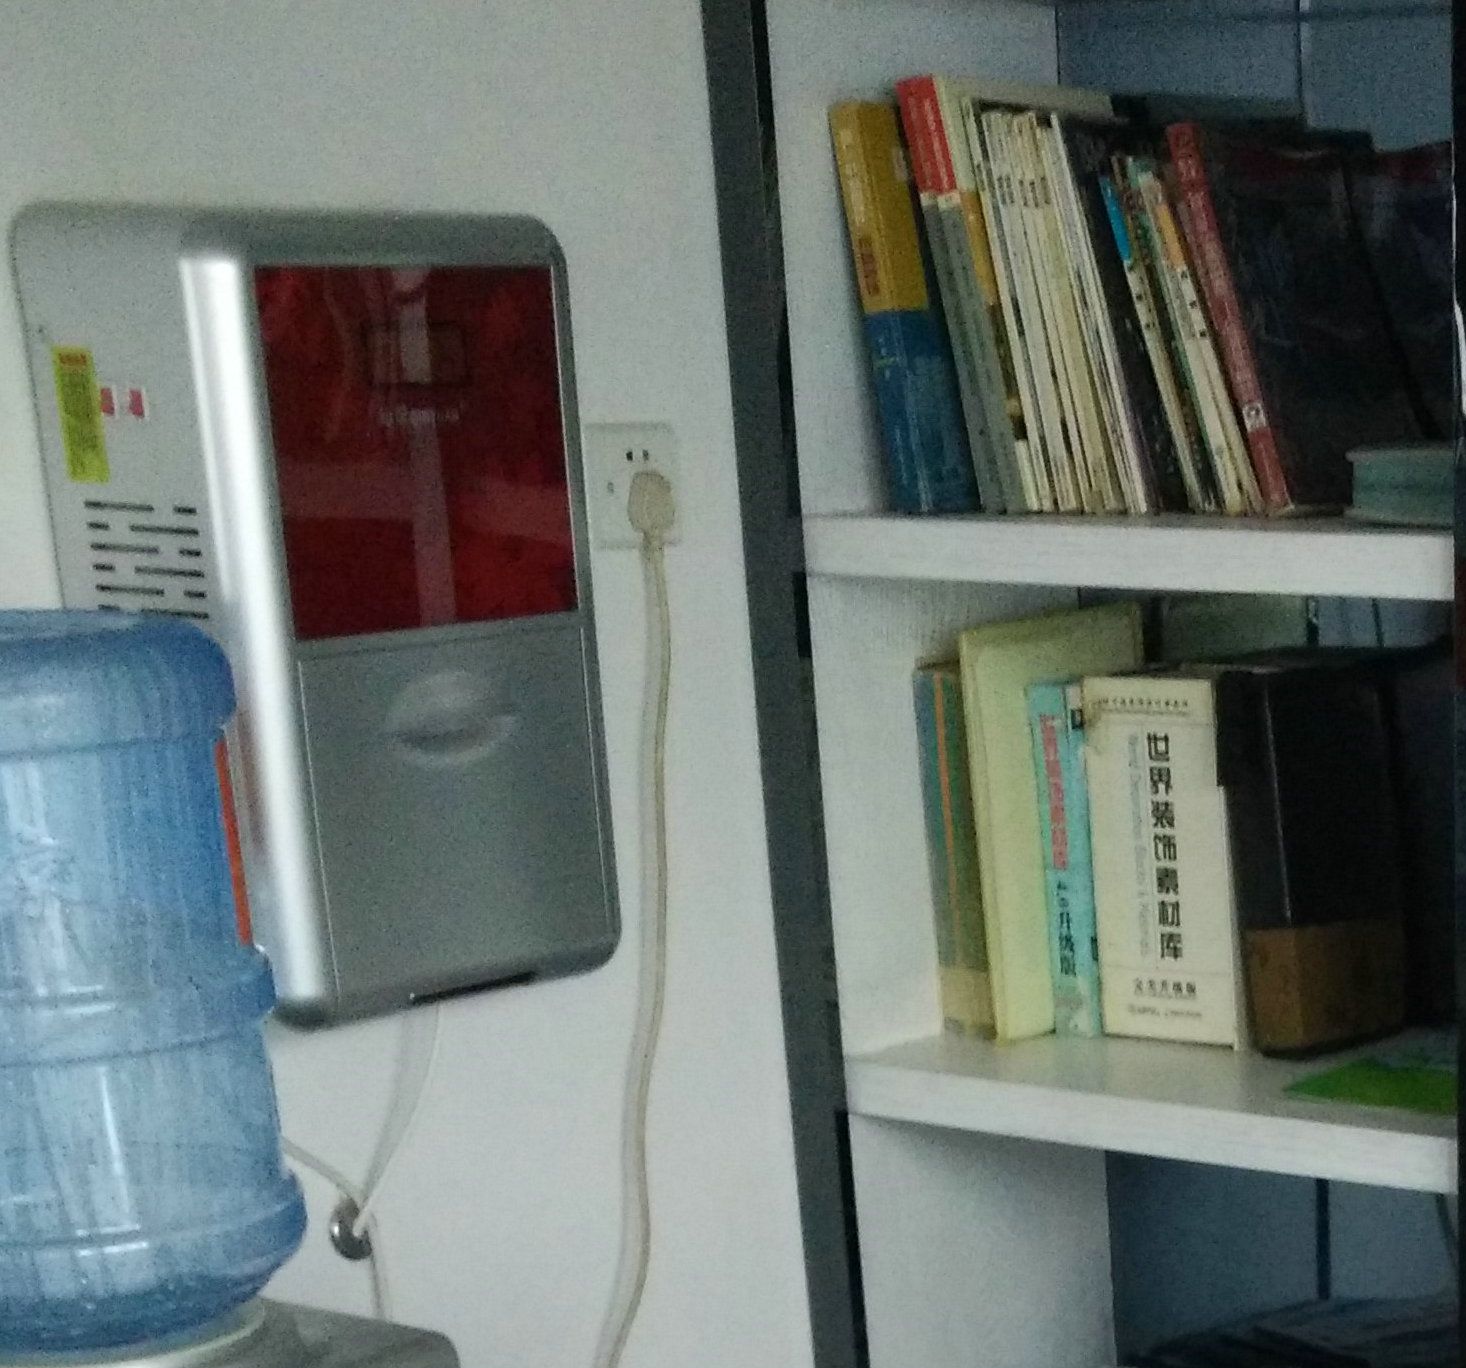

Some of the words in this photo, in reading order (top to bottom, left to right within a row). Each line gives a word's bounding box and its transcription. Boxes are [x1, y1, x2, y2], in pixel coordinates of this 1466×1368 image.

[1146, 731, 1184, 962] 世界装饰素材库
